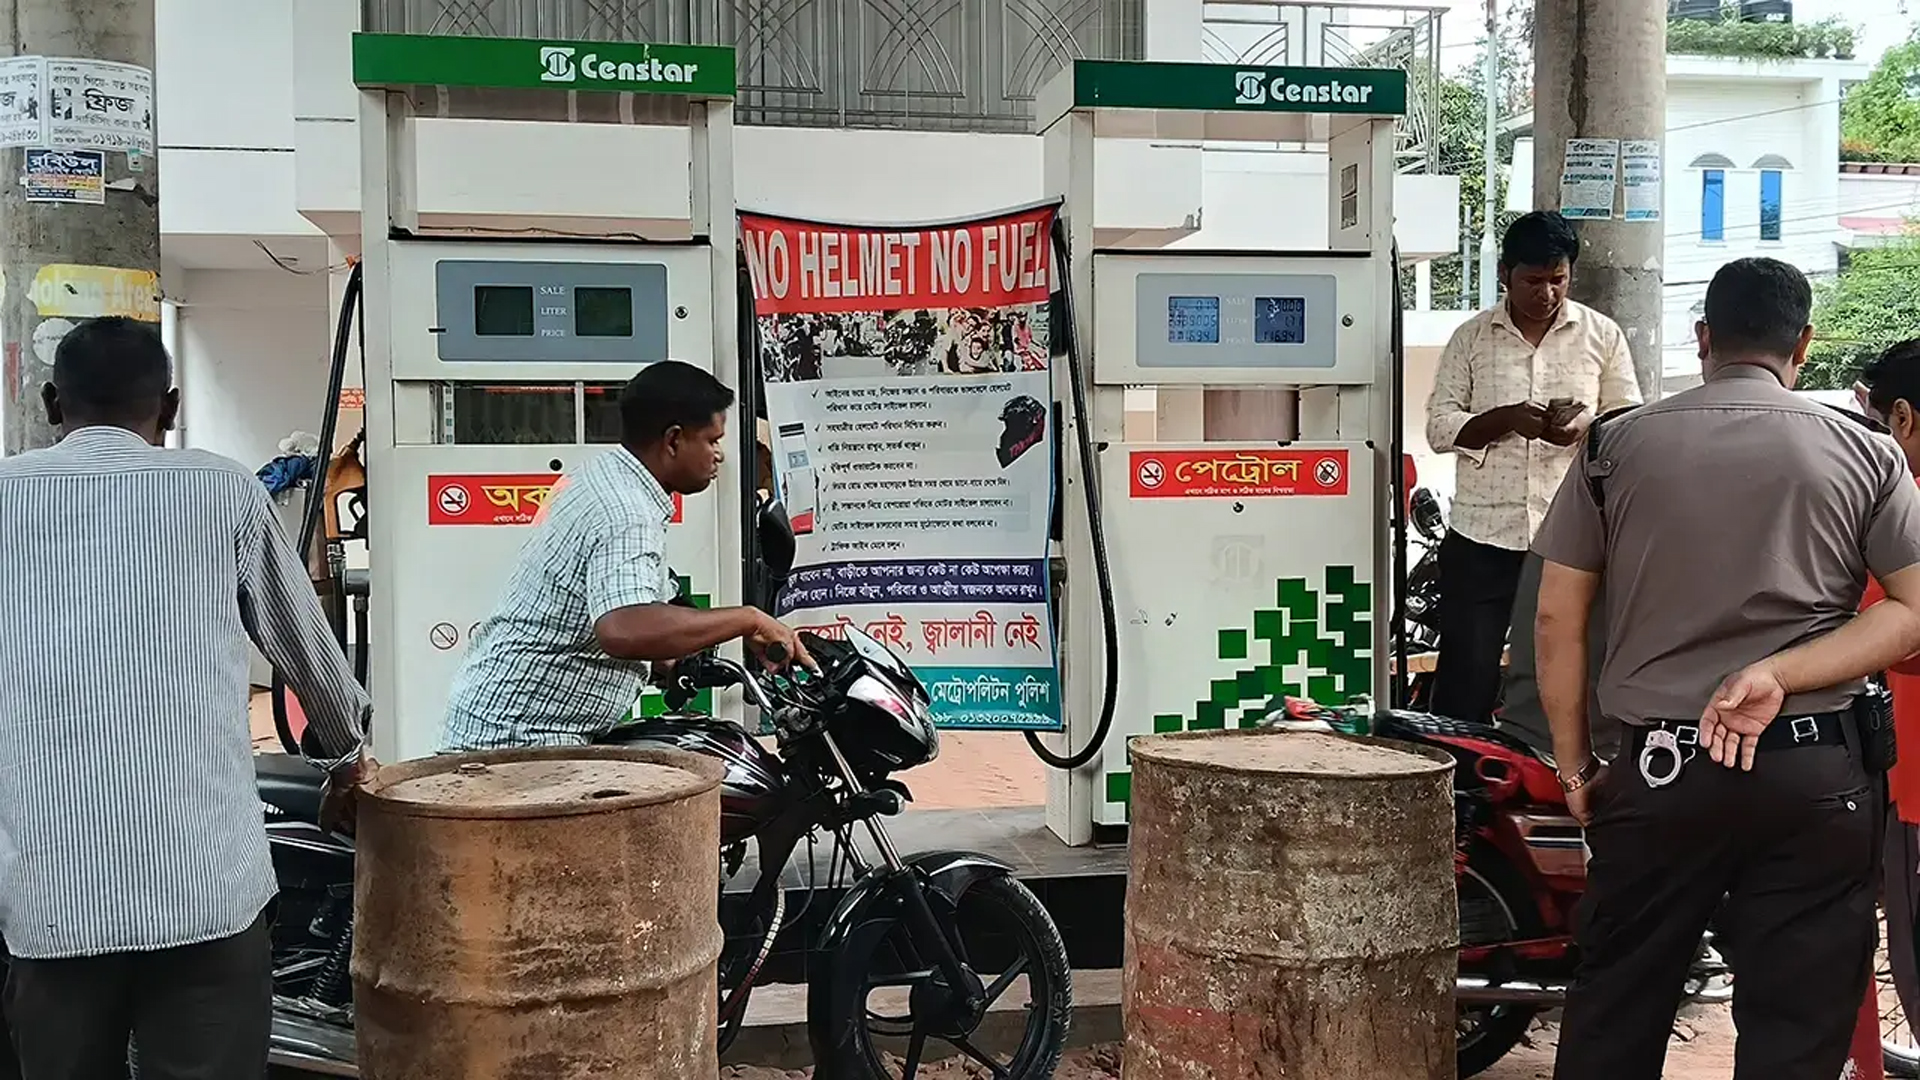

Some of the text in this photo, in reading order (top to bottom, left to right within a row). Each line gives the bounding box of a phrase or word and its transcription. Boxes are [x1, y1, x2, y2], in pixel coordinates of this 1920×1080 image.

[580, 53, 698, 83] Censtar
[82, 88, 135, 114] ফ্রিজ
[1270, 77, 1373, 103] Censtar
[744, 221, 1048, 300] NO HELMET NO FUEL
[540, 286, 566, 295] SALE
[540, 306, 567, 316] LITER
[541, 328, 566, 338] PRICE
[1175, 452, 1304, 485] পেট্রোল
[870, 565, 904, 577] আপনার
[905, 564, 925, 577] জন্য
[927, 561, 947, 576] কেউ
[948, 564, 959, 576] না
[961, 561, 980, 576] কেউ
[981, 564, 1010, 576] অপেক্ষা
[835, 583, 857, 598] নিজে
[886, 581, 917, 597] পরিবার
[919, 584, 928, 595] ও
[864, 612, 914, 653] নেই,
[920, 610, 997, 655] জ্বালানী
[1004, 612, 1043, 651] নেই
[931, 674, 1051, 708] মেট্রোপলিটন পুলিশ
